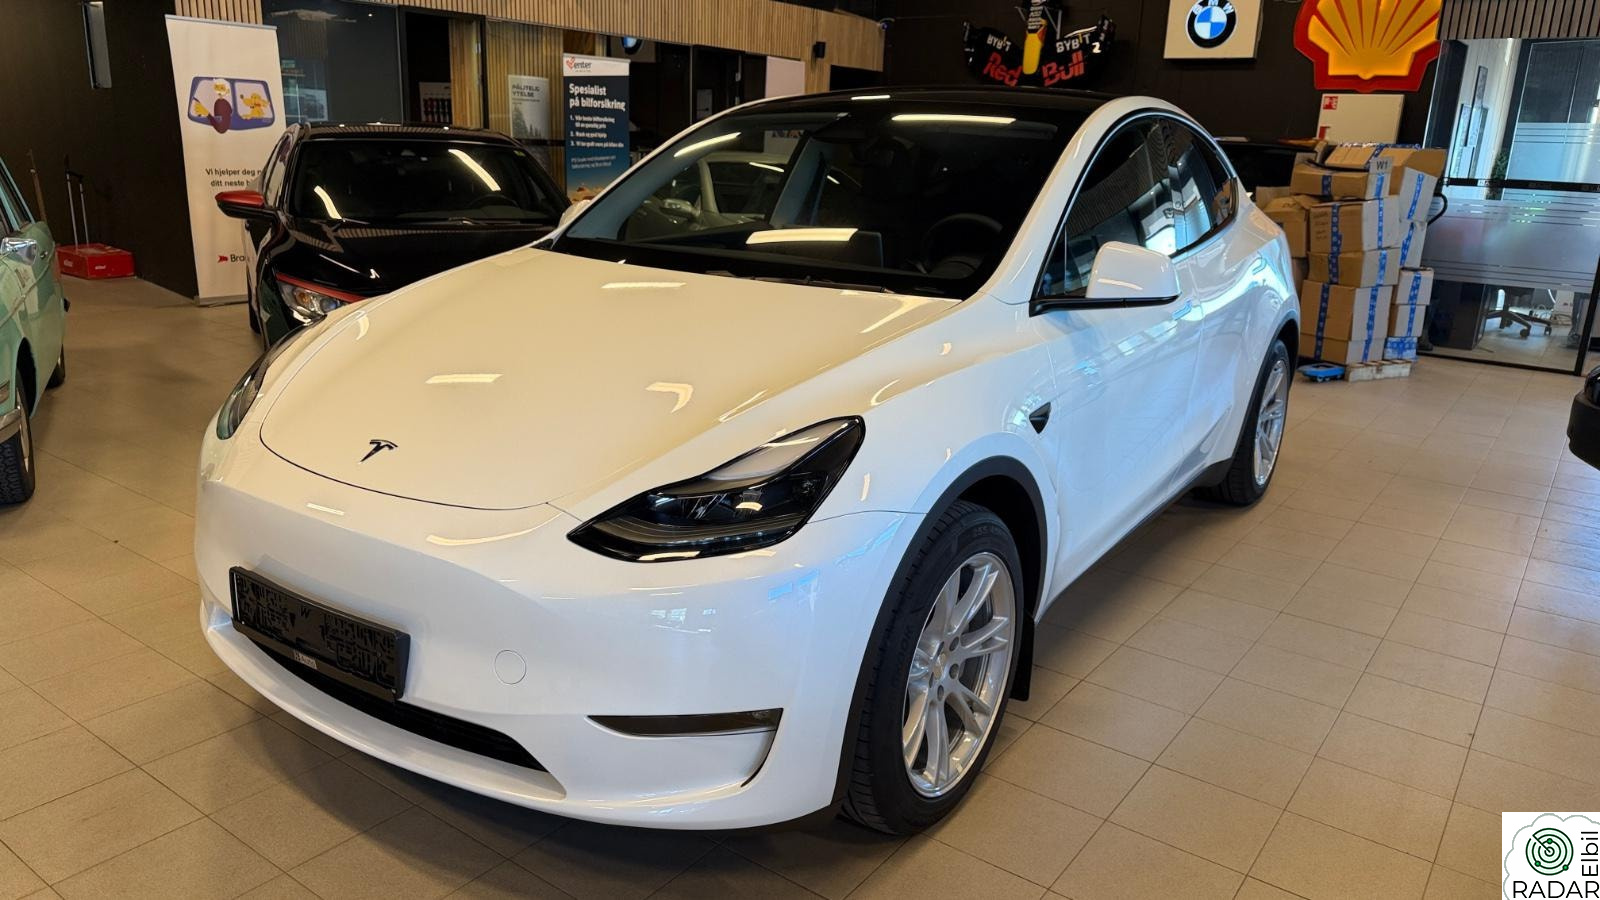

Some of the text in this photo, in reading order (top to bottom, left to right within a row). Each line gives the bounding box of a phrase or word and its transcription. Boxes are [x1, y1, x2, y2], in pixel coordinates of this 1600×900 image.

[1055, 32, 1091, 53] BYBIT
[1091, 42, 1102, 53] 2
[983, 50, 1085, 88] Red Bull
[569, 83, 607, 96] Spesialist
[569, 96, 626, 112] på bilforsikring
[215, 168, 240, 176] hjelper
[241, 168, 255, 176] deg
